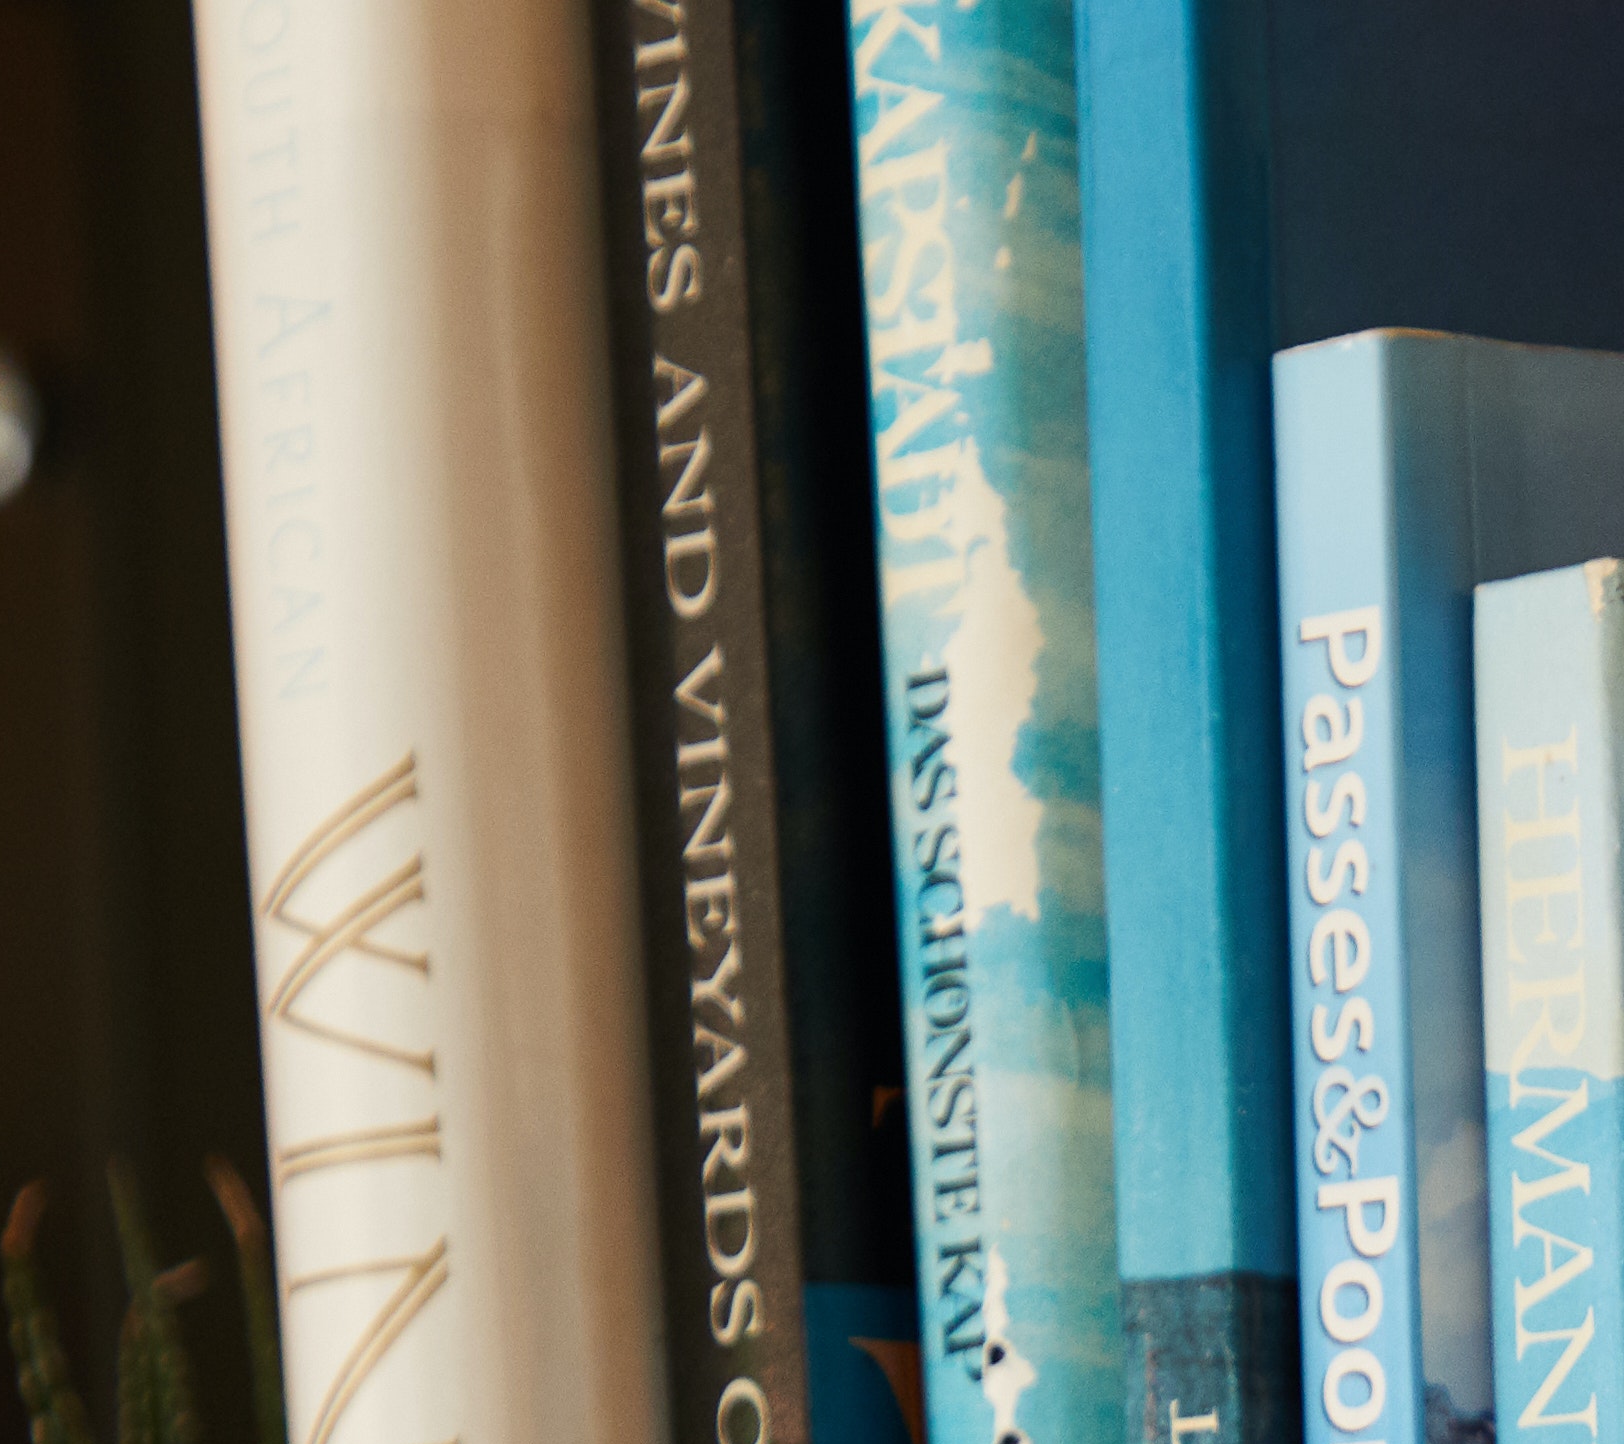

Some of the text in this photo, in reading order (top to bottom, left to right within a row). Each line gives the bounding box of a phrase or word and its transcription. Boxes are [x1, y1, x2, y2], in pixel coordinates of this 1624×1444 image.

[253, 296, 333, 705] AFRICAN
[652, 352, 719, 619] AND
[672, 643, 765, 1348] VINEYARDS
[905, 667, 956, 815] DAS
[938, 1238, 987, 1386] KAP
